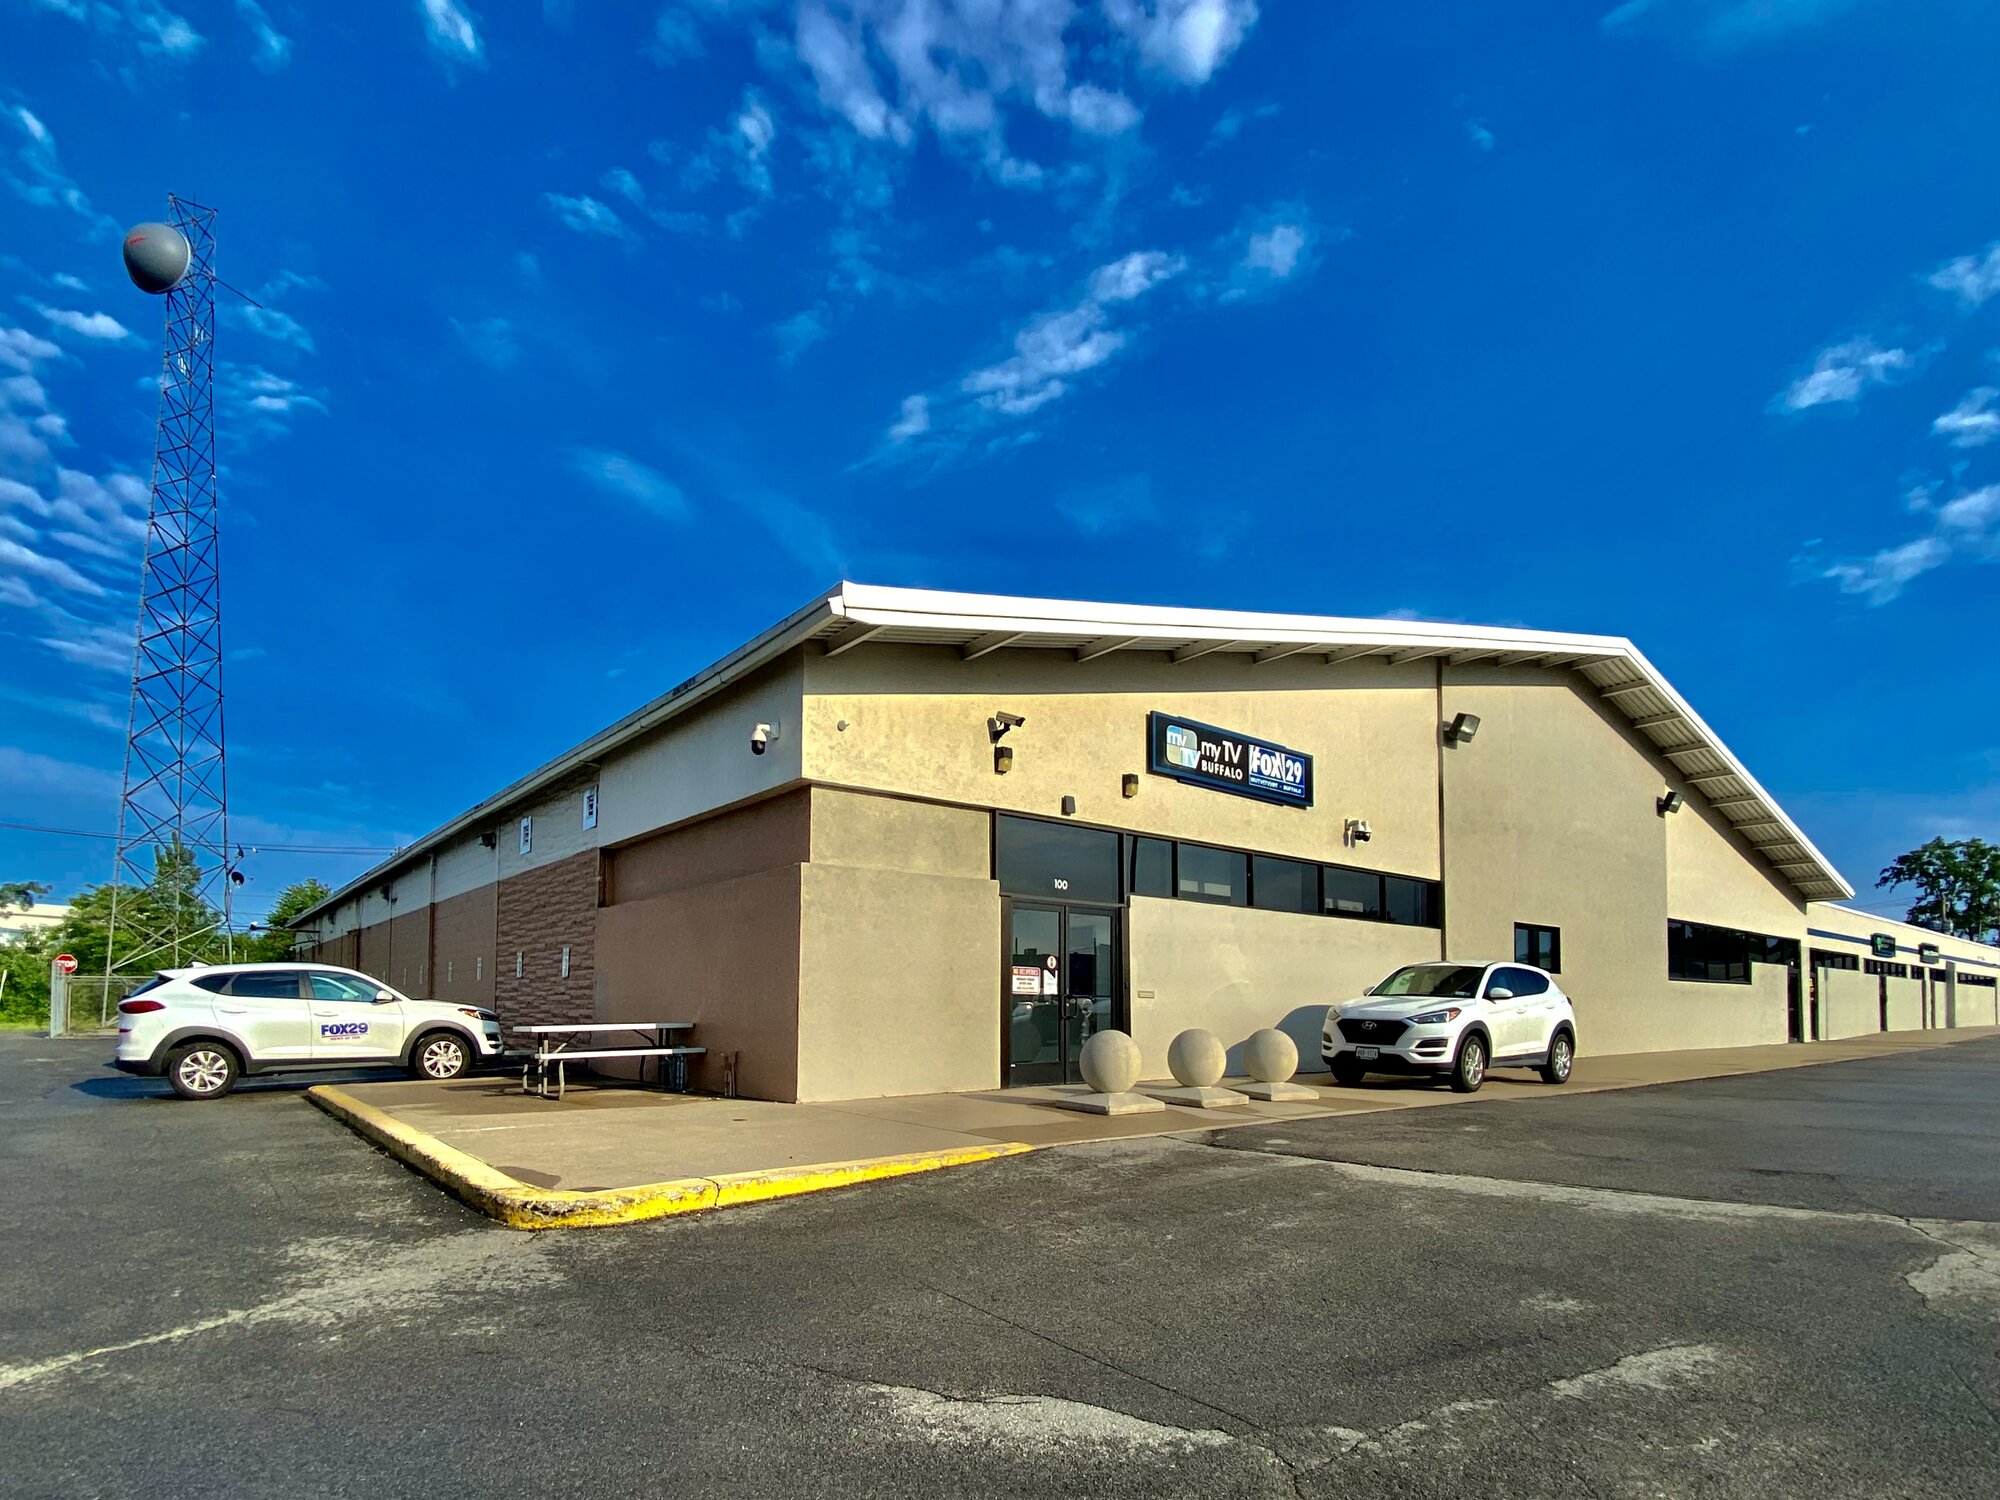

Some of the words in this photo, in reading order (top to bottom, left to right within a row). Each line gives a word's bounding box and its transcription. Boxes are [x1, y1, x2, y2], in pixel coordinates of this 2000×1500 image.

[1201, 760, 1243, 780] BUFFALO
[1252, 752, 1281, 779] FOX
[1286, 758, 1303, 783] 29
[1054, 878, 1068, 890] 100
[321, 1022, 368, 1036] FOX29
